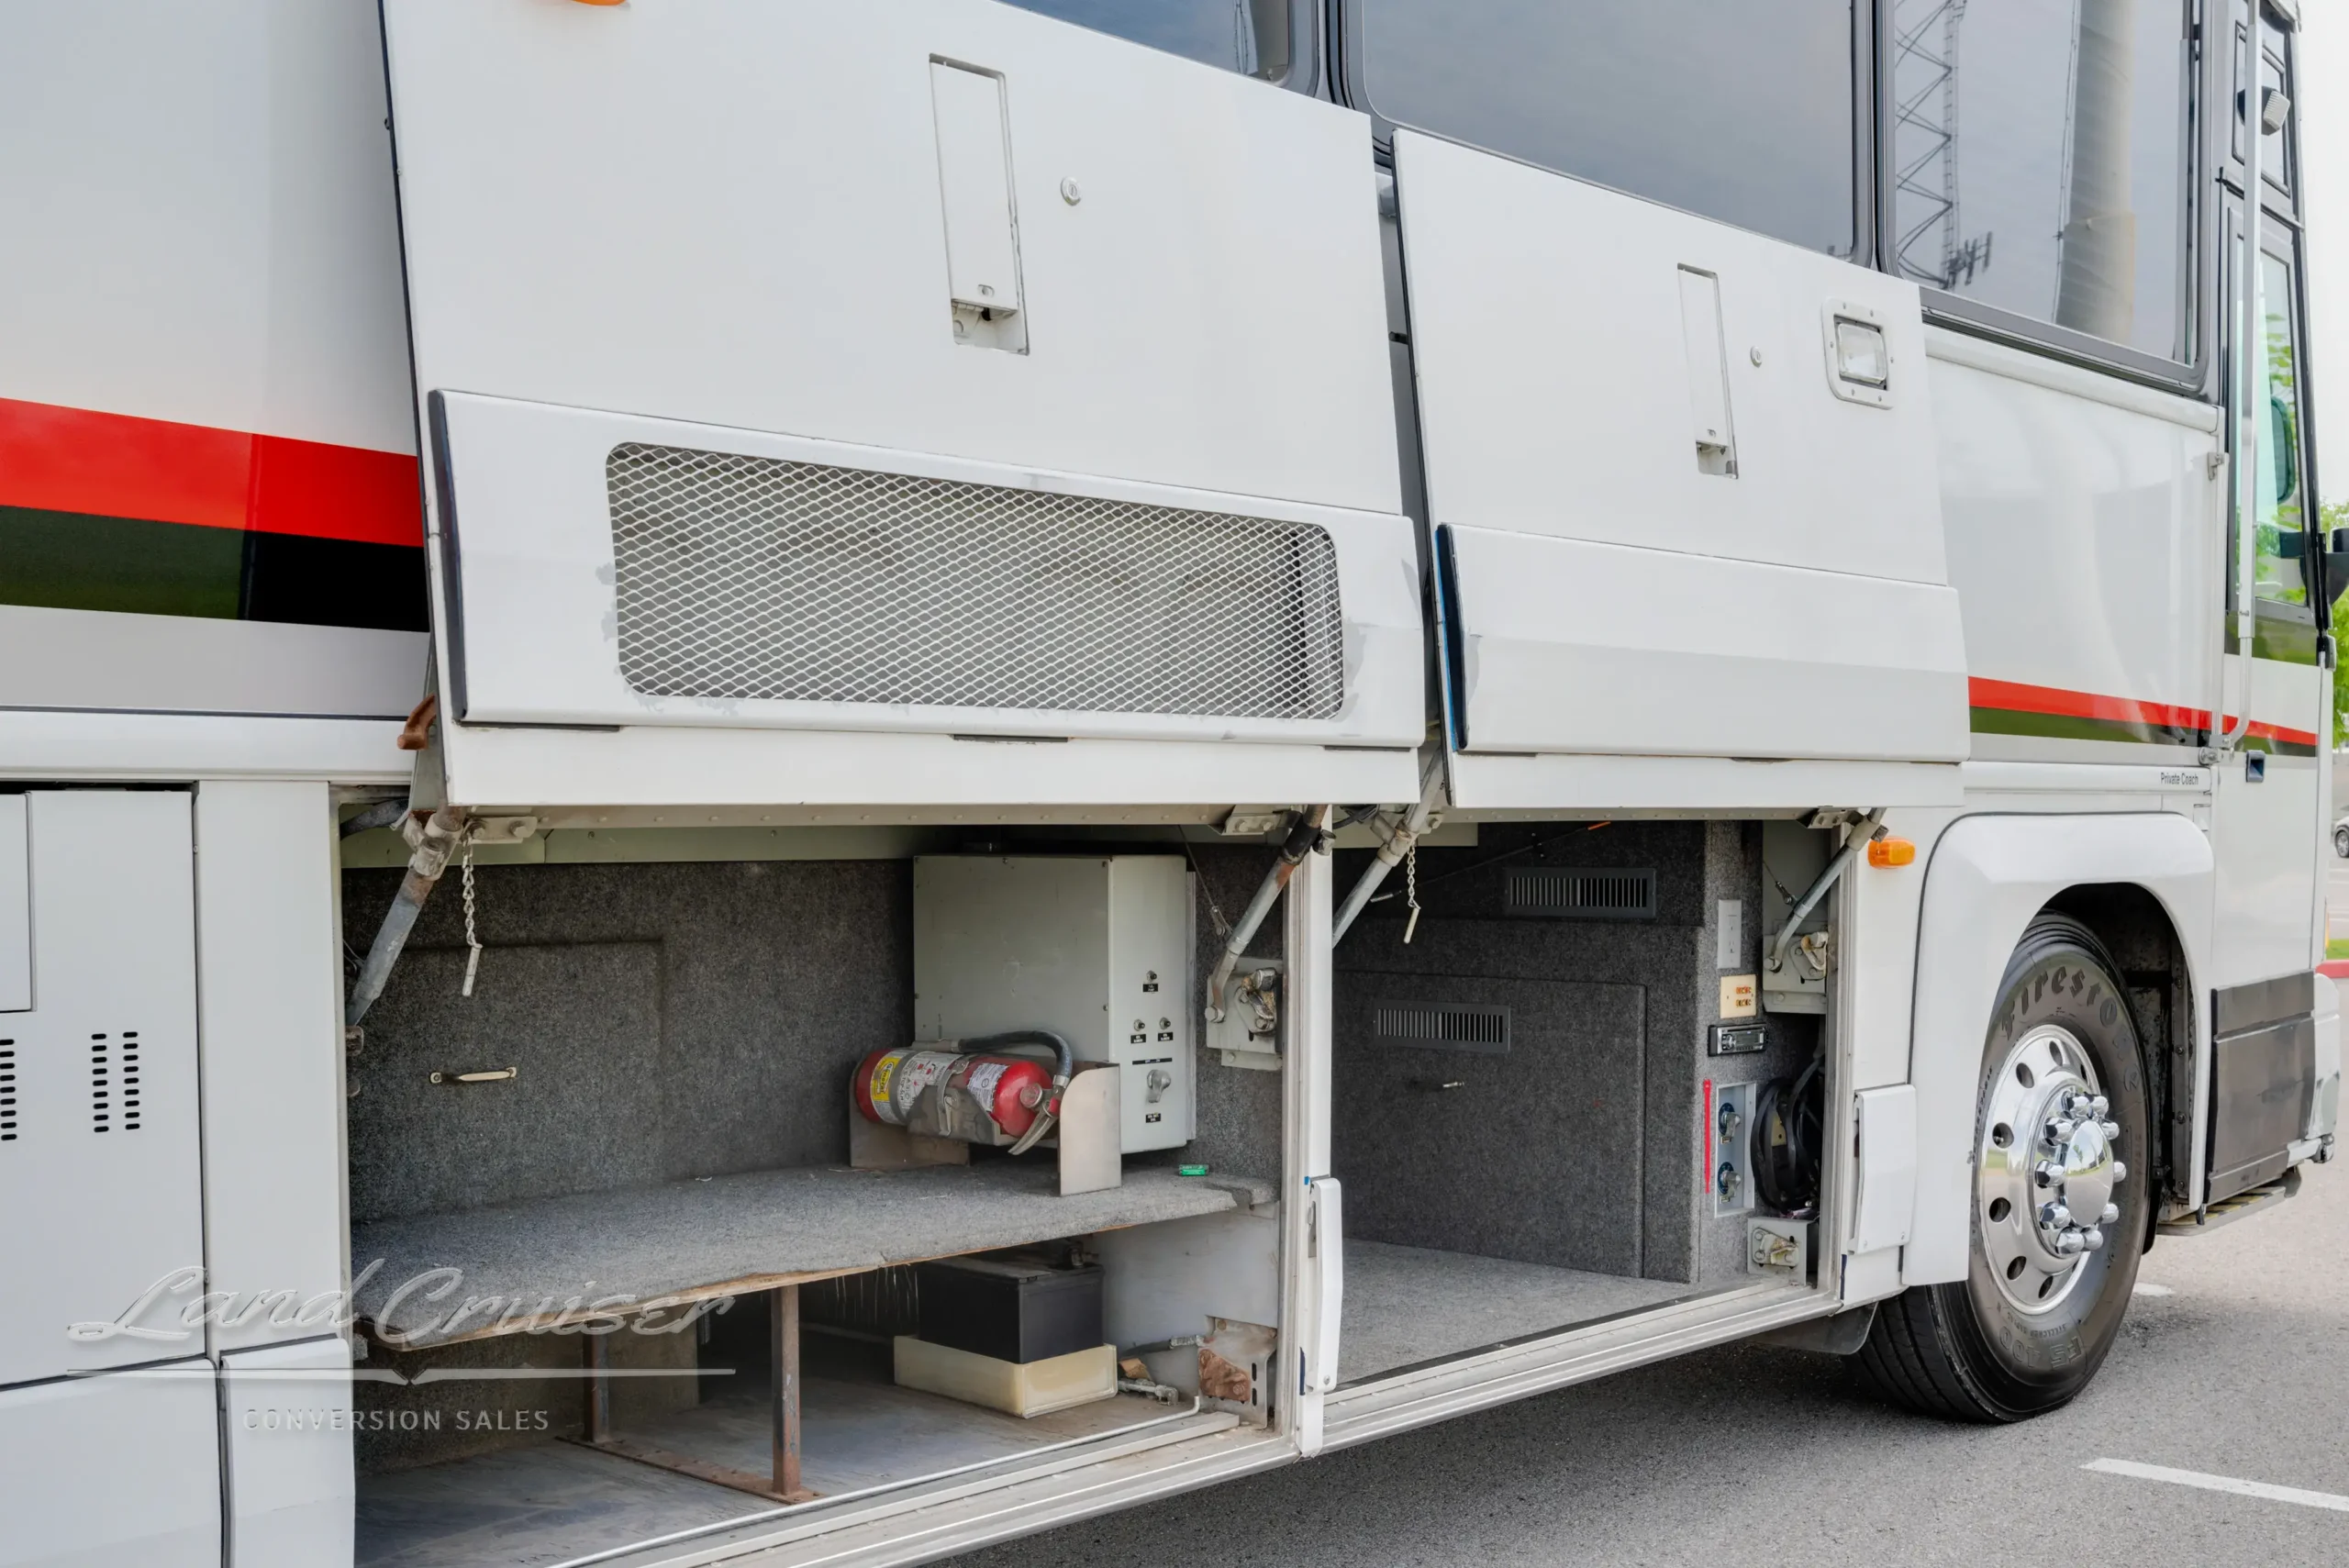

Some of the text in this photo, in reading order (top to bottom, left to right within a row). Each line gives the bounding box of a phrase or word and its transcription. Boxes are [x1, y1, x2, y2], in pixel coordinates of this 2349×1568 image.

[2161, 772, 2199, 785] Private Coach
[1999, 965, 2142, 1093] Firestone
[1999, 1326, 2083, 1369] FS 400
